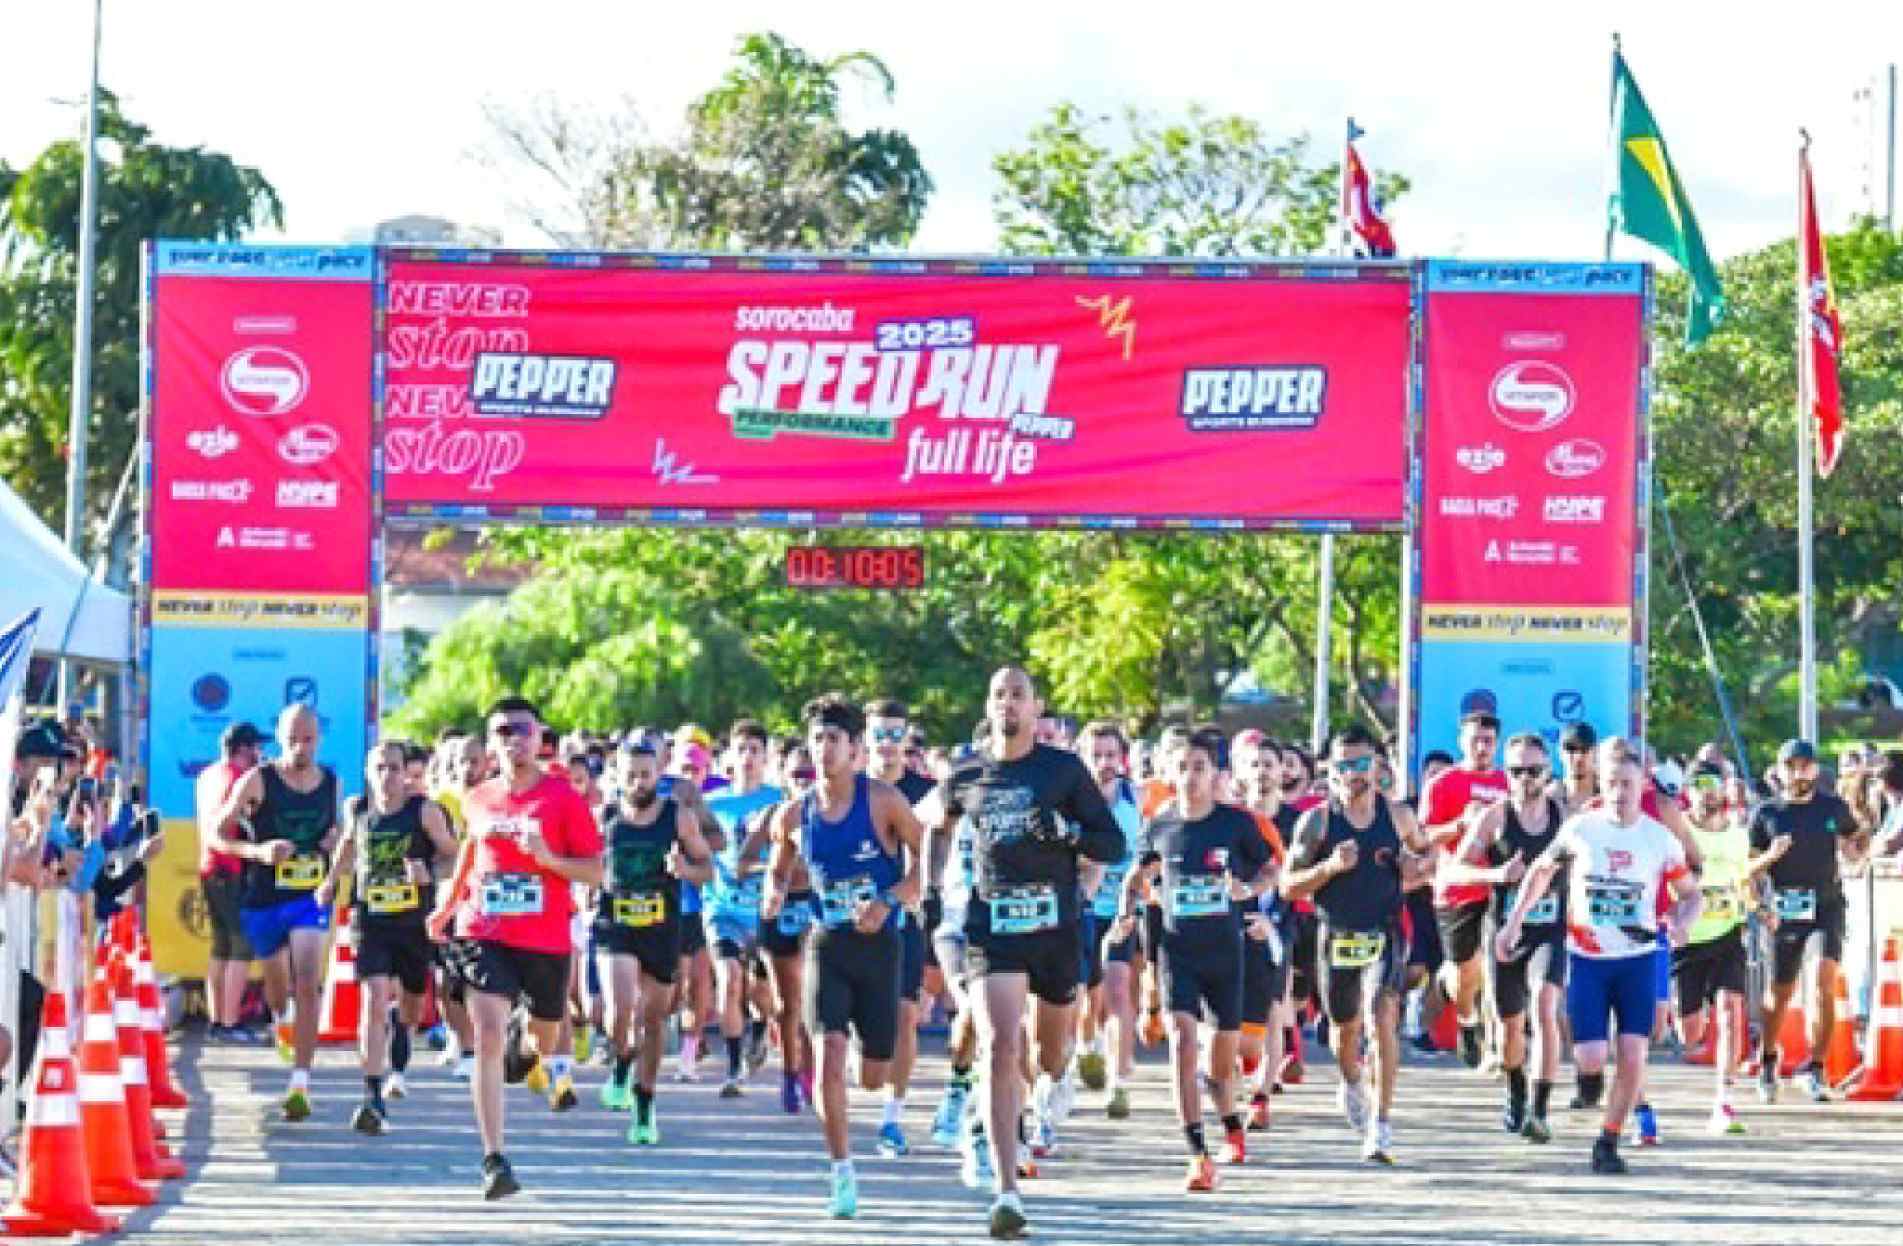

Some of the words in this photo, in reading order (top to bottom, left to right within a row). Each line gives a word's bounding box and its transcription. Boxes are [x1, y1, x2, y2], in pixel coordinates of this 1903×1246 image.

[317, 251, 365, 270] pace
[1586, 268, 1632, 286] pace
[388, 281, 531, 317] NEVER
[734, 300, 854, 331] sorocaba
[878, 319, 973, 348] 2025
[474, 353, 614, 406] PEPPER
[717, 340, 920, 419] SPEED
[916, 344, 1060, 419] RUN
[1184, 370, 1323, 414] PEPPER
[736, 411, 892, 436] PERFORMANCE
[384, 419, 525, 492] stop
[901, 427, 969, 483] full
[972, 428, 1038, 485] life
[157, 600, 213, 615] NEVER
[262, 602, 318, 616] NEVER
[1428, 614, 1482, 628] NEVER
[1486, 613, 1524, 635] stop
[1529, 616, 1582, 629] NEVER
